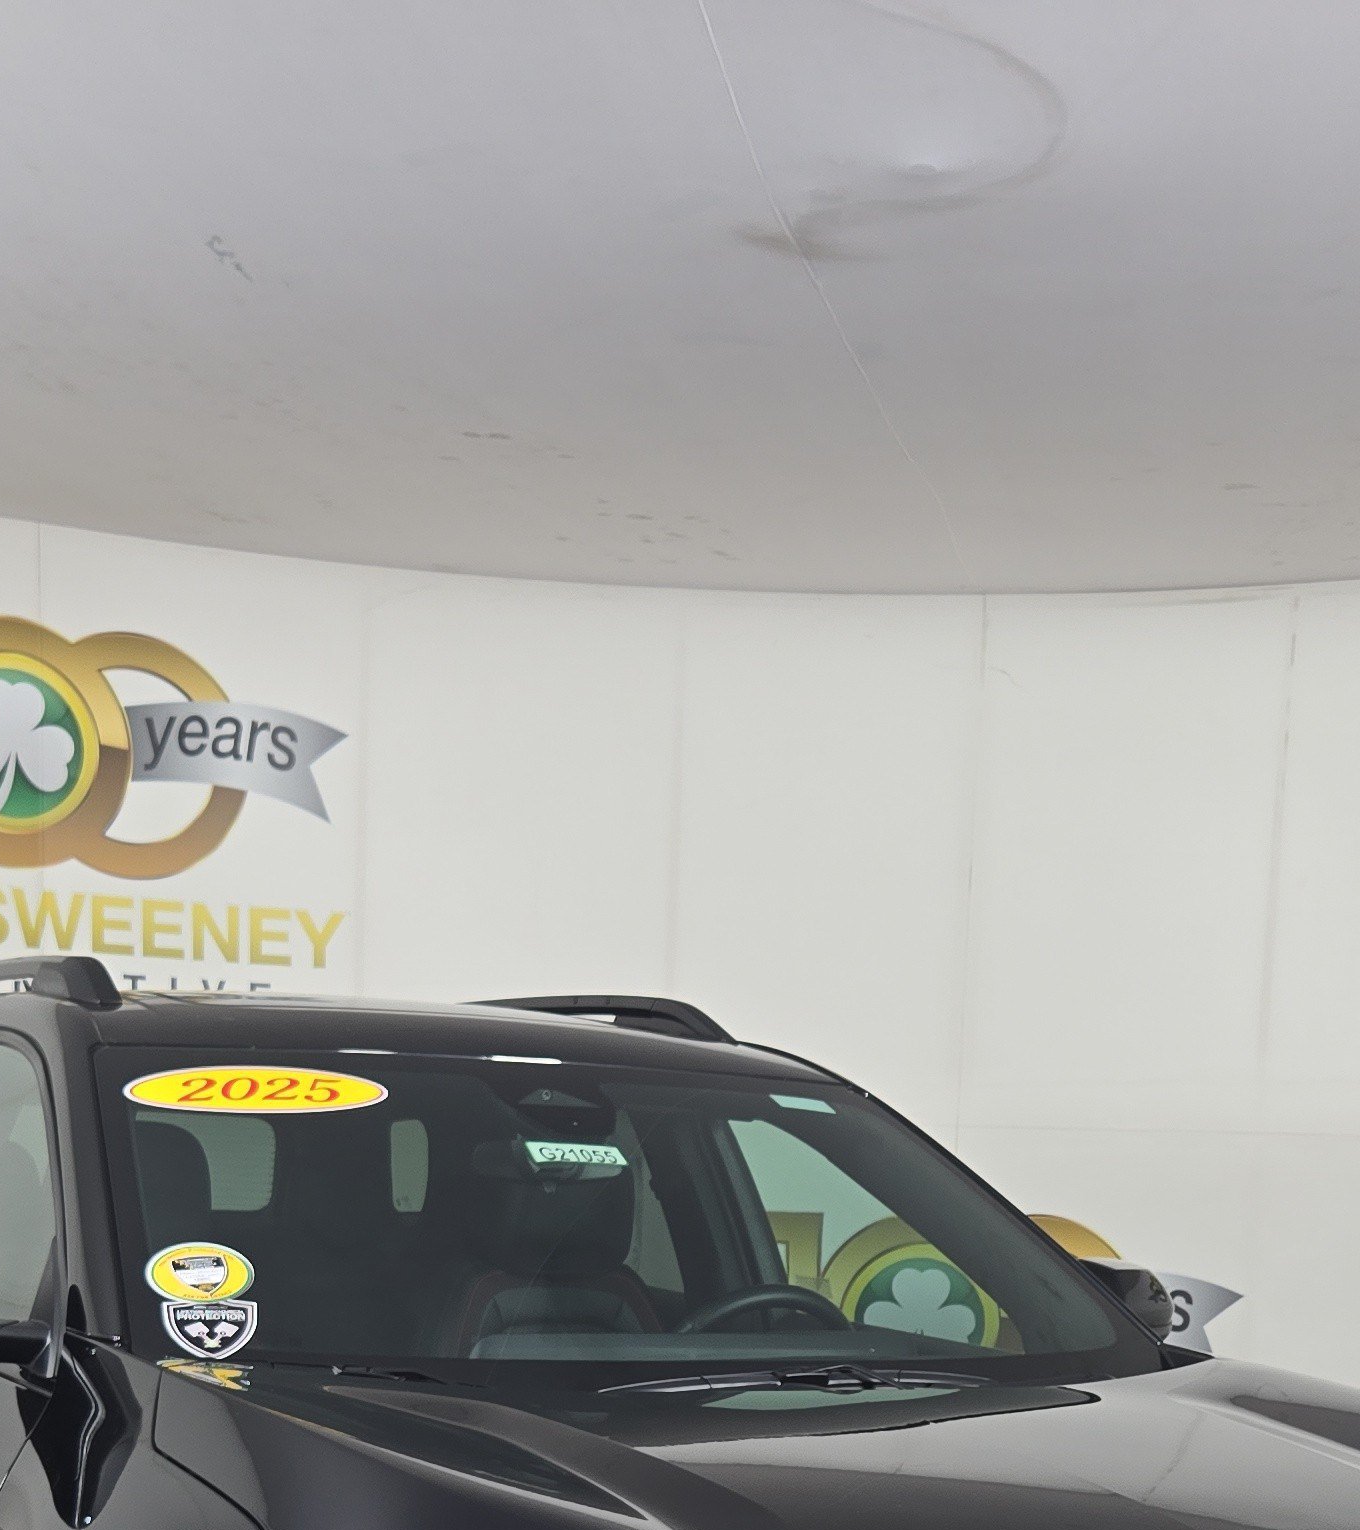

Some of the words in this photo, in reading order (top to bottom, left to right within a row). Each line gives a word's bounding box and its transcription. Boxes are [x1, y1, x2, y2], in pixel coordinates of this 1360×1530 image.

[144, 714, 300, 772] years
[177, 1076, 342, 1103] 2025
[538, 1146, 618, 1164] G21055
